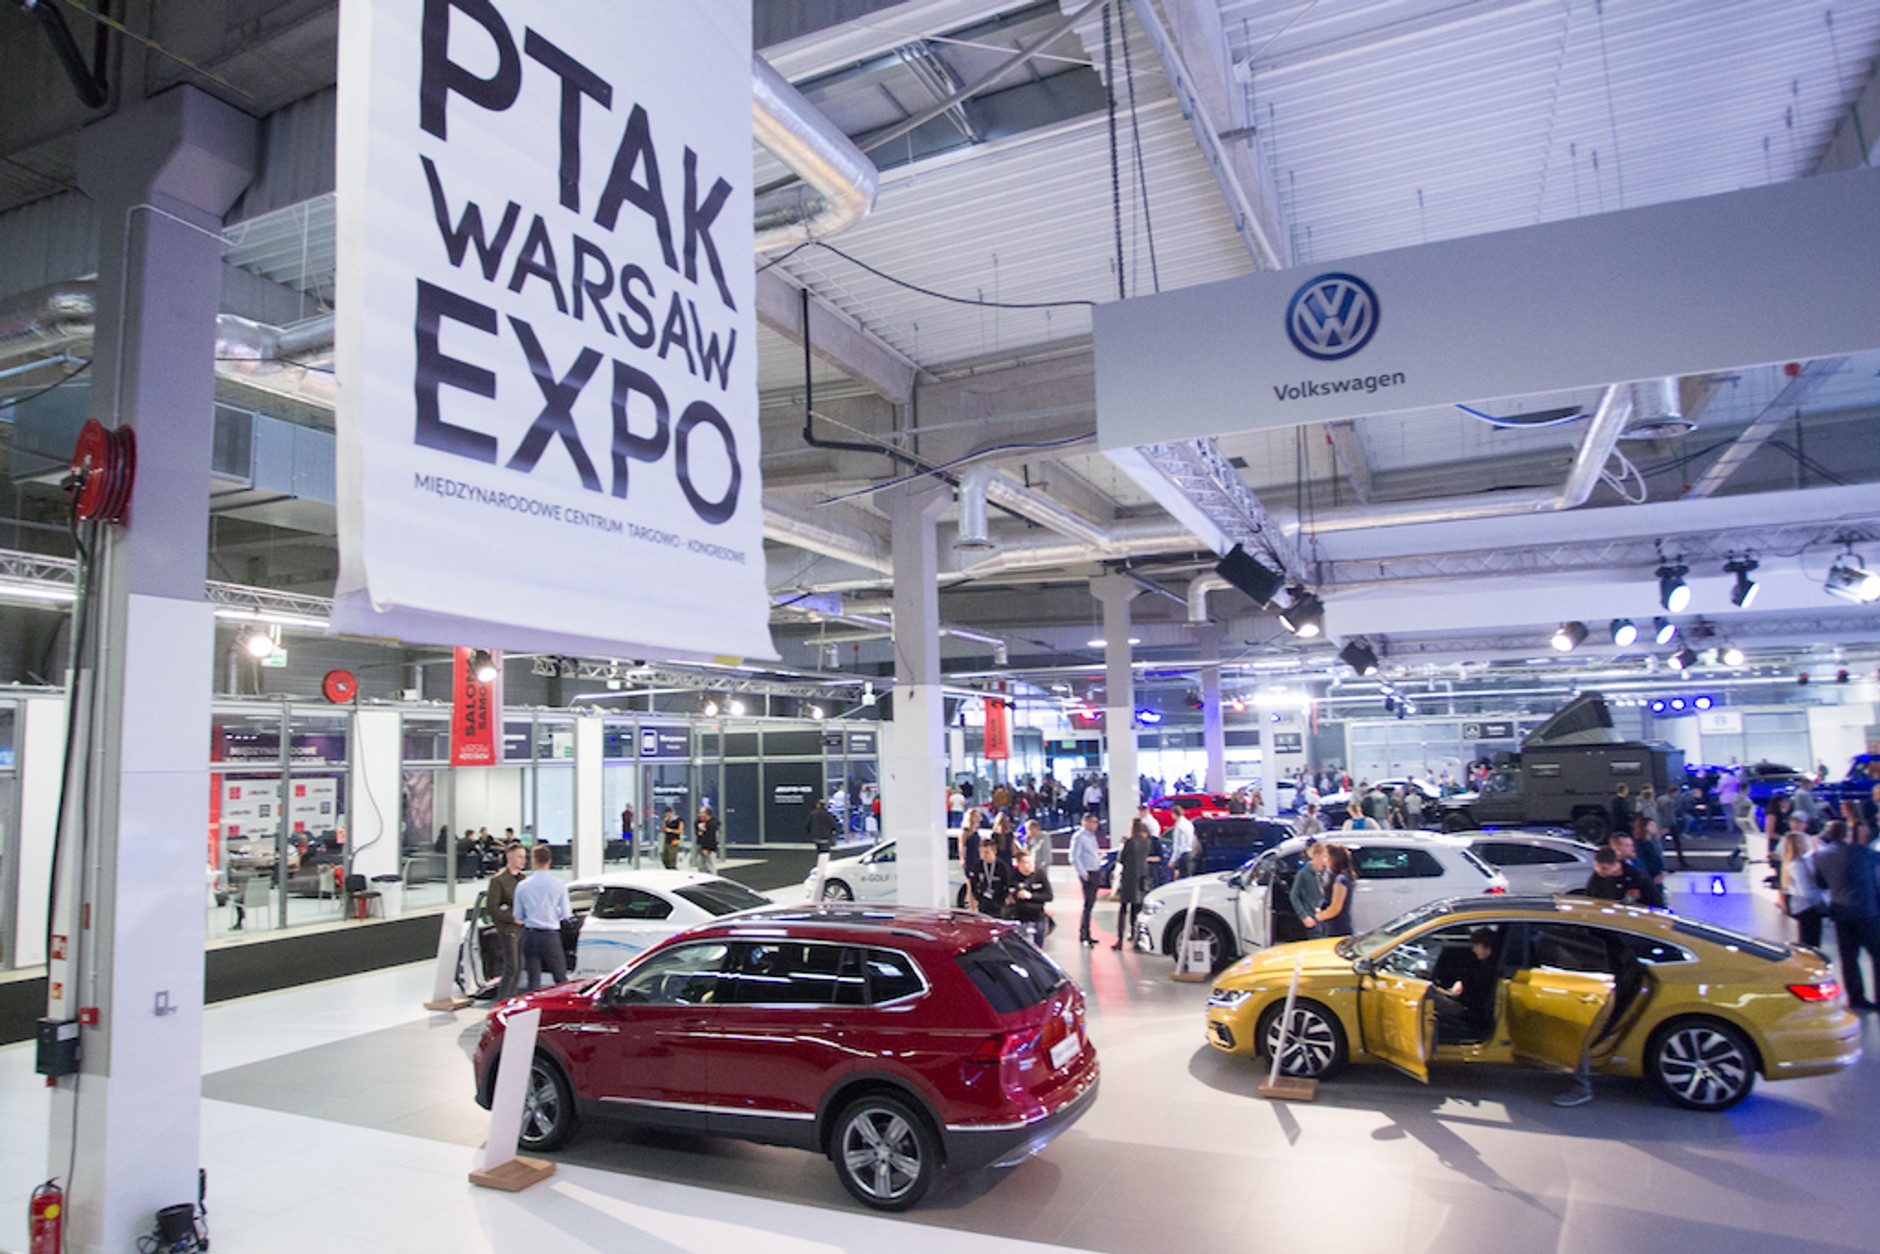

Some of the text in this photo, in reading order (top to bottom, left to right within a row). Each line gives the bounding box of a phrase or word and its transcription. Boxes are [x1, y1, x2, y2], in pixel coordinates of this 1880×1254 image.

[418, 153, 737, 391] WARSAW
[421, 0, 738, 313] PTAK
[414, 277, 742, 525] EXPO
[1273, 370, 1406, 402] Volkswagen
[414, 472, 562, 521] MIĘDZYNARODOWE
[564, 507, 623, 535] CENTRUM
[627, 522, 681, 549] TARGOWO
[687, 539, 746, 566] KONGRESOWE
